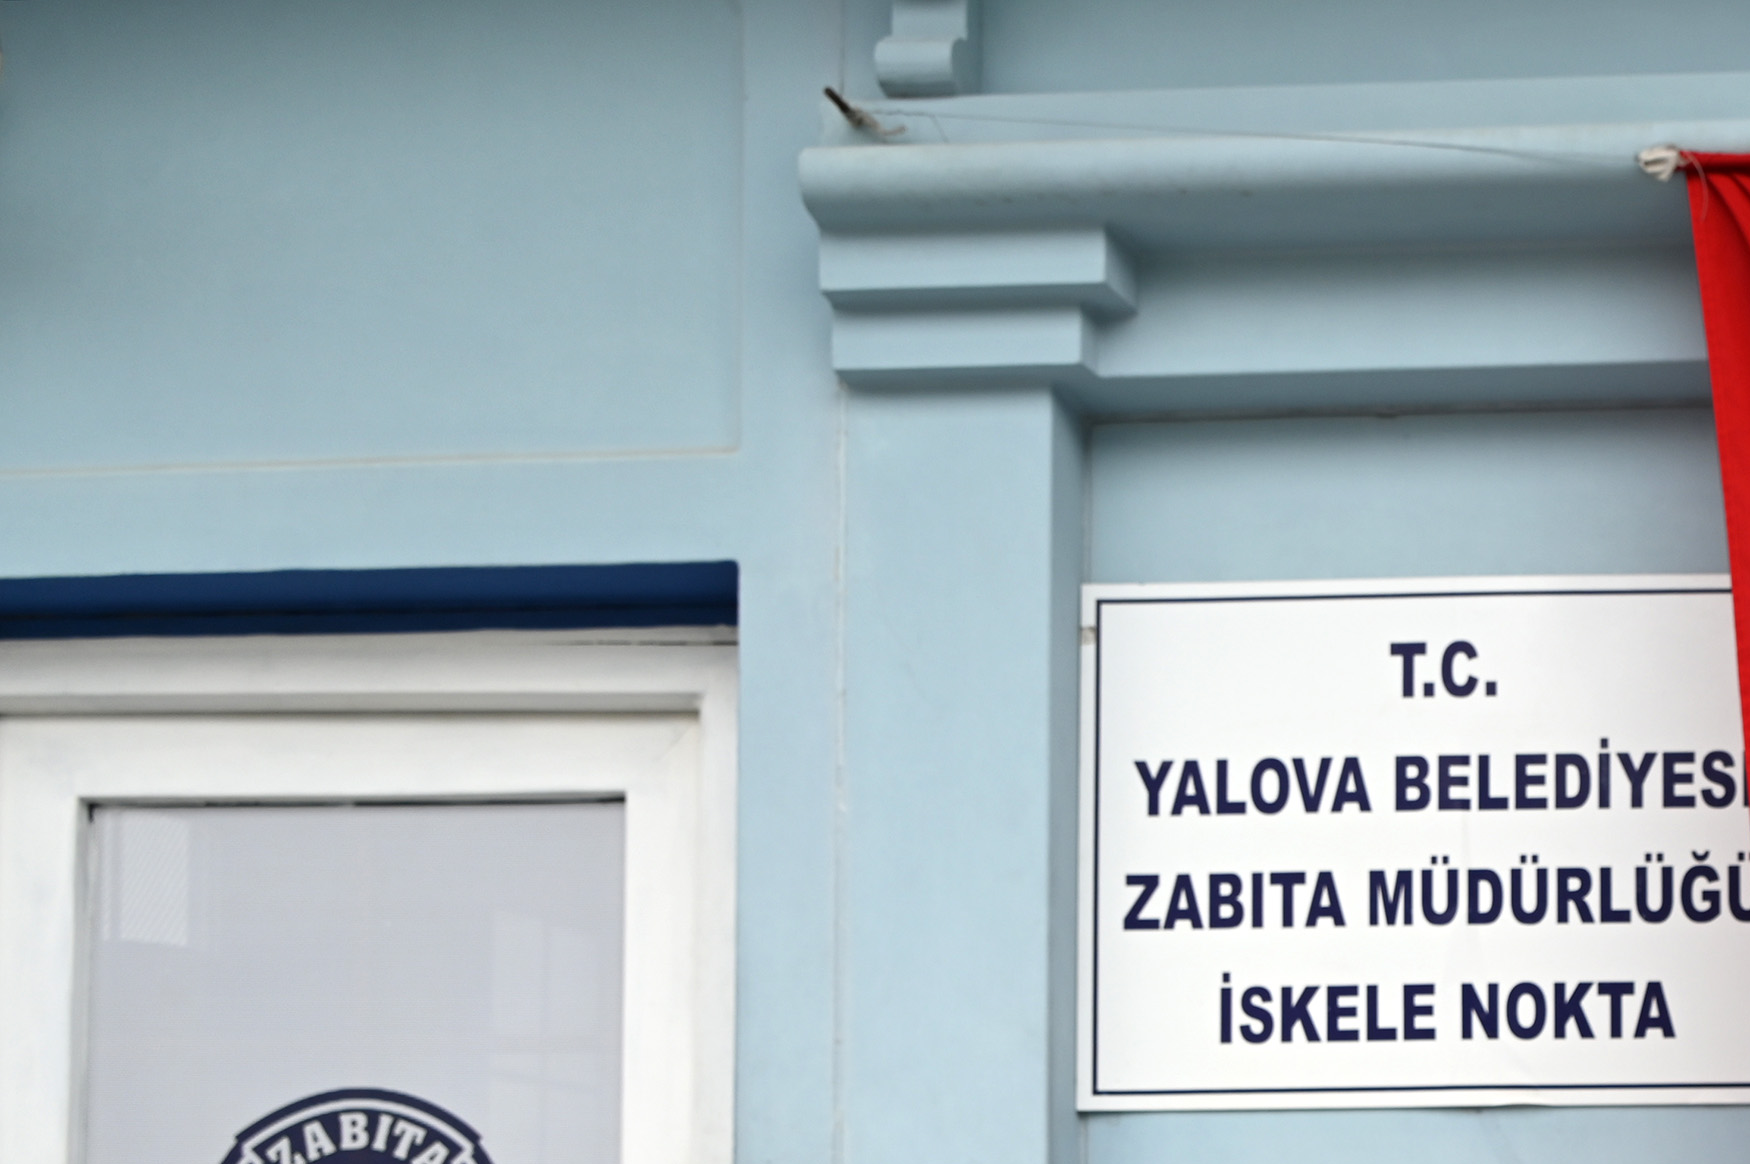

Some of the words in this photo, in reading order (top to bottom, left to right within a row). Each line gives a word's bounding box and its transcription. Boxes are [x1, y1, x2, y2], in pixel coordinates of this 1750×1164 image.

[1390, 640, 1497, 698] T.C.
[1134, 756, 1372, 816] YALOVA
[1123, 870, 1346, 931] ZABITA
[1219, 972, 1436, 1044] İSKELE
[1460, 981, 1676, 1040] NOKTA
